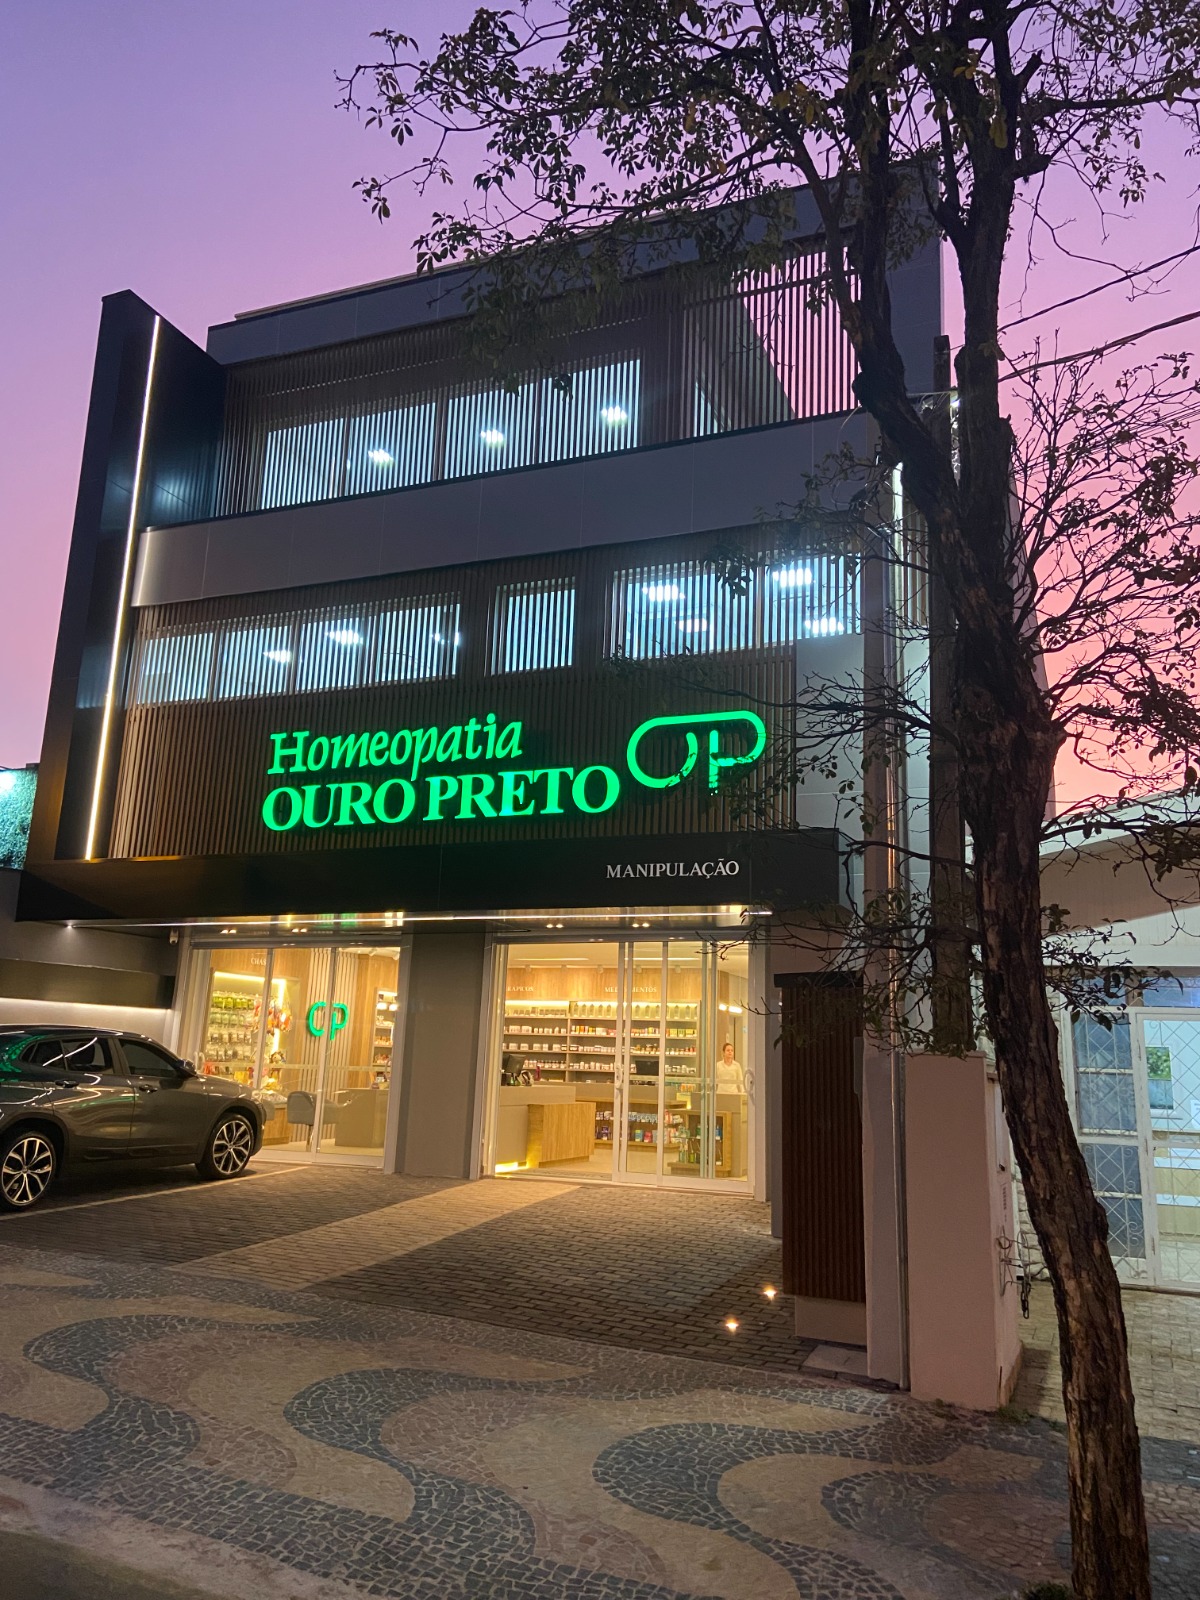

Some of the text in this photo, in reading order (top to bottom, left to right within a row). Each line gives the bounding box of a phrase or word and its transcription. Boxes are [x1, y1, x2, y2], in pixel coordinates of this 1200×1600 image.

[267, 712, 523, 781] Homeopatia
[261, 765, 621, 831] OURO PRETO
[606, 858, 740, 879] MANIPULAÇÃO
